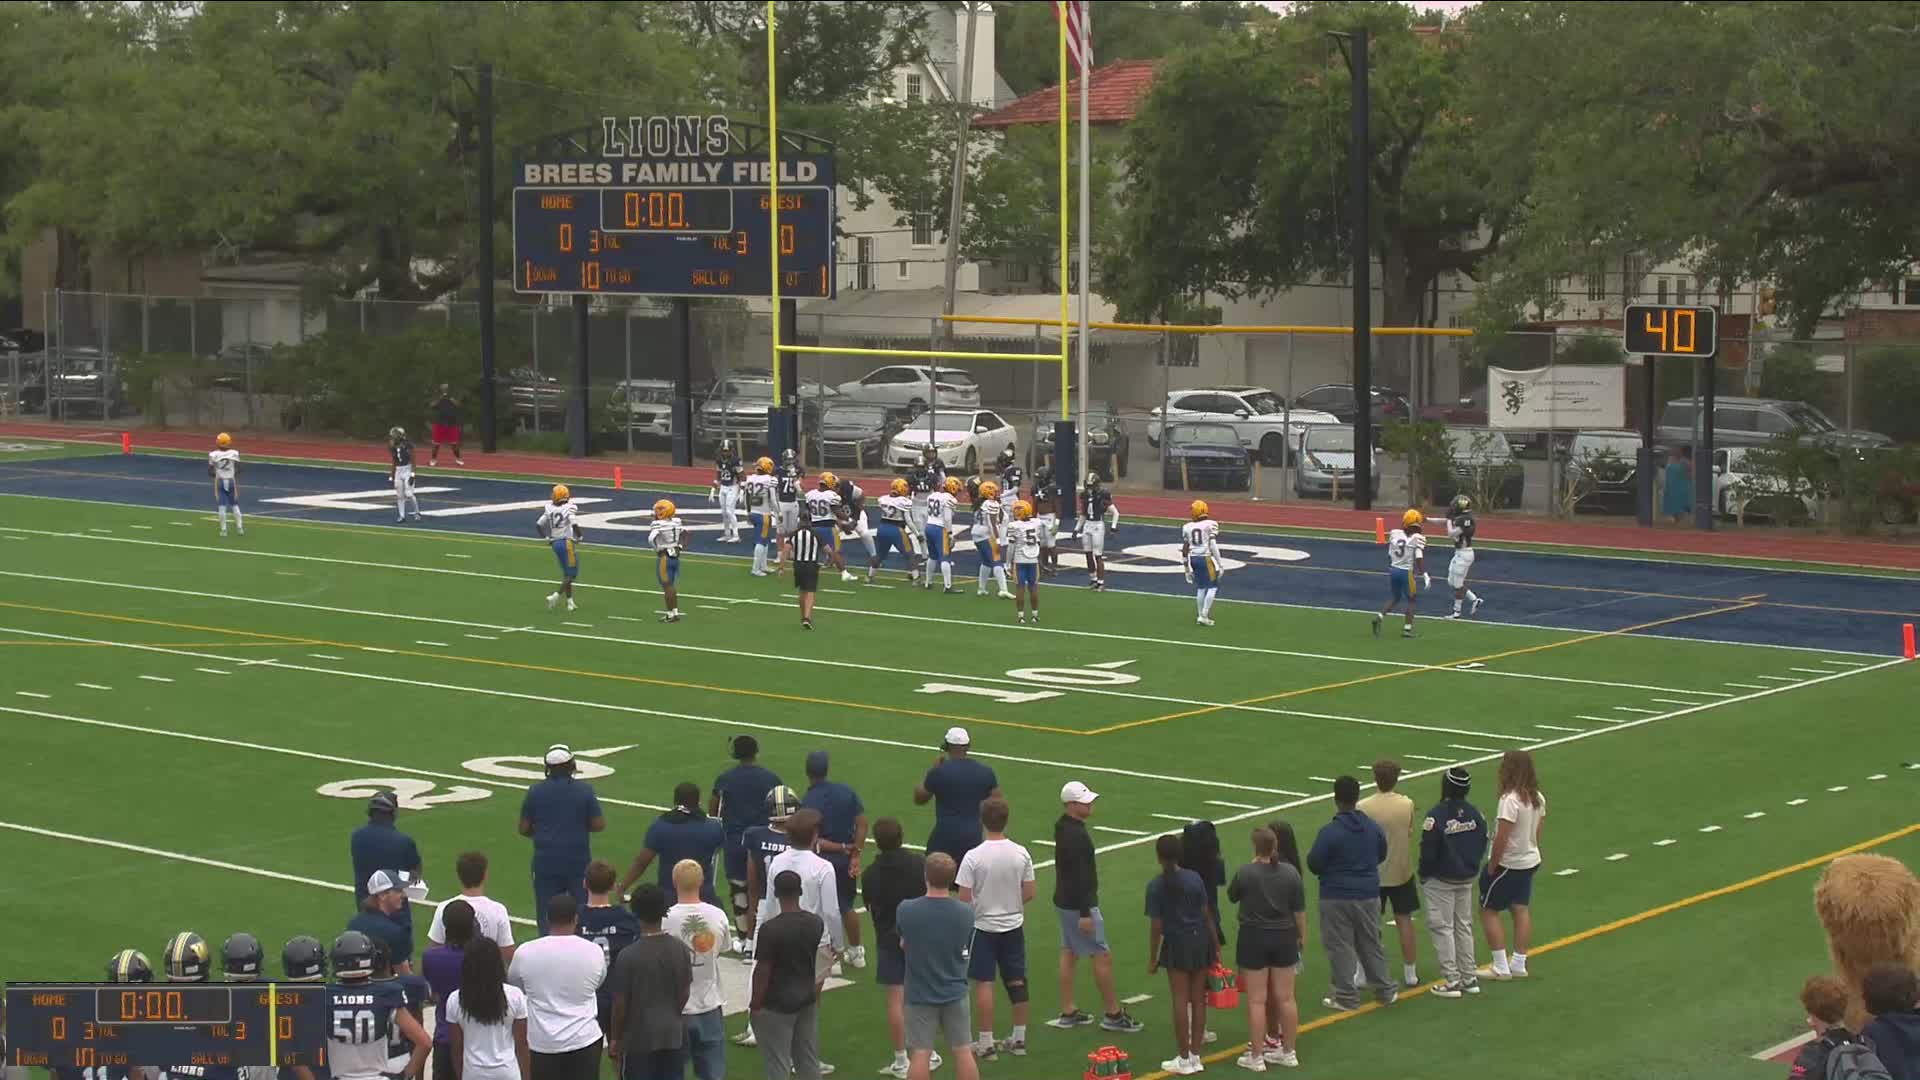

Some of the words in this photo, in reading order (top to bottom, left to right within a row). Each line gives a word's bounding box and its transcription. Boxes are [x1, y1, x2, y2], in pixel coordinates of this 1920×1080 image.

[602, 115, 729, 157] LIONS
[524, 164, 612, 184] BREES
[622, 163, 722, 184] FAMILY
[733, 162, 817, 183] FIELD
[760, 195, 804, 210] GEST
[560, 223, 573, 251] 0
[780, 224, 795, 256] 0
[1646, 309, 1696, 352] 40
[912, 667, 1142, 703] 10
[315, 756, 616, 811] 20
[333, 995, 374, 1005] LIONS
[332, 1010, 375, 1045] 50
